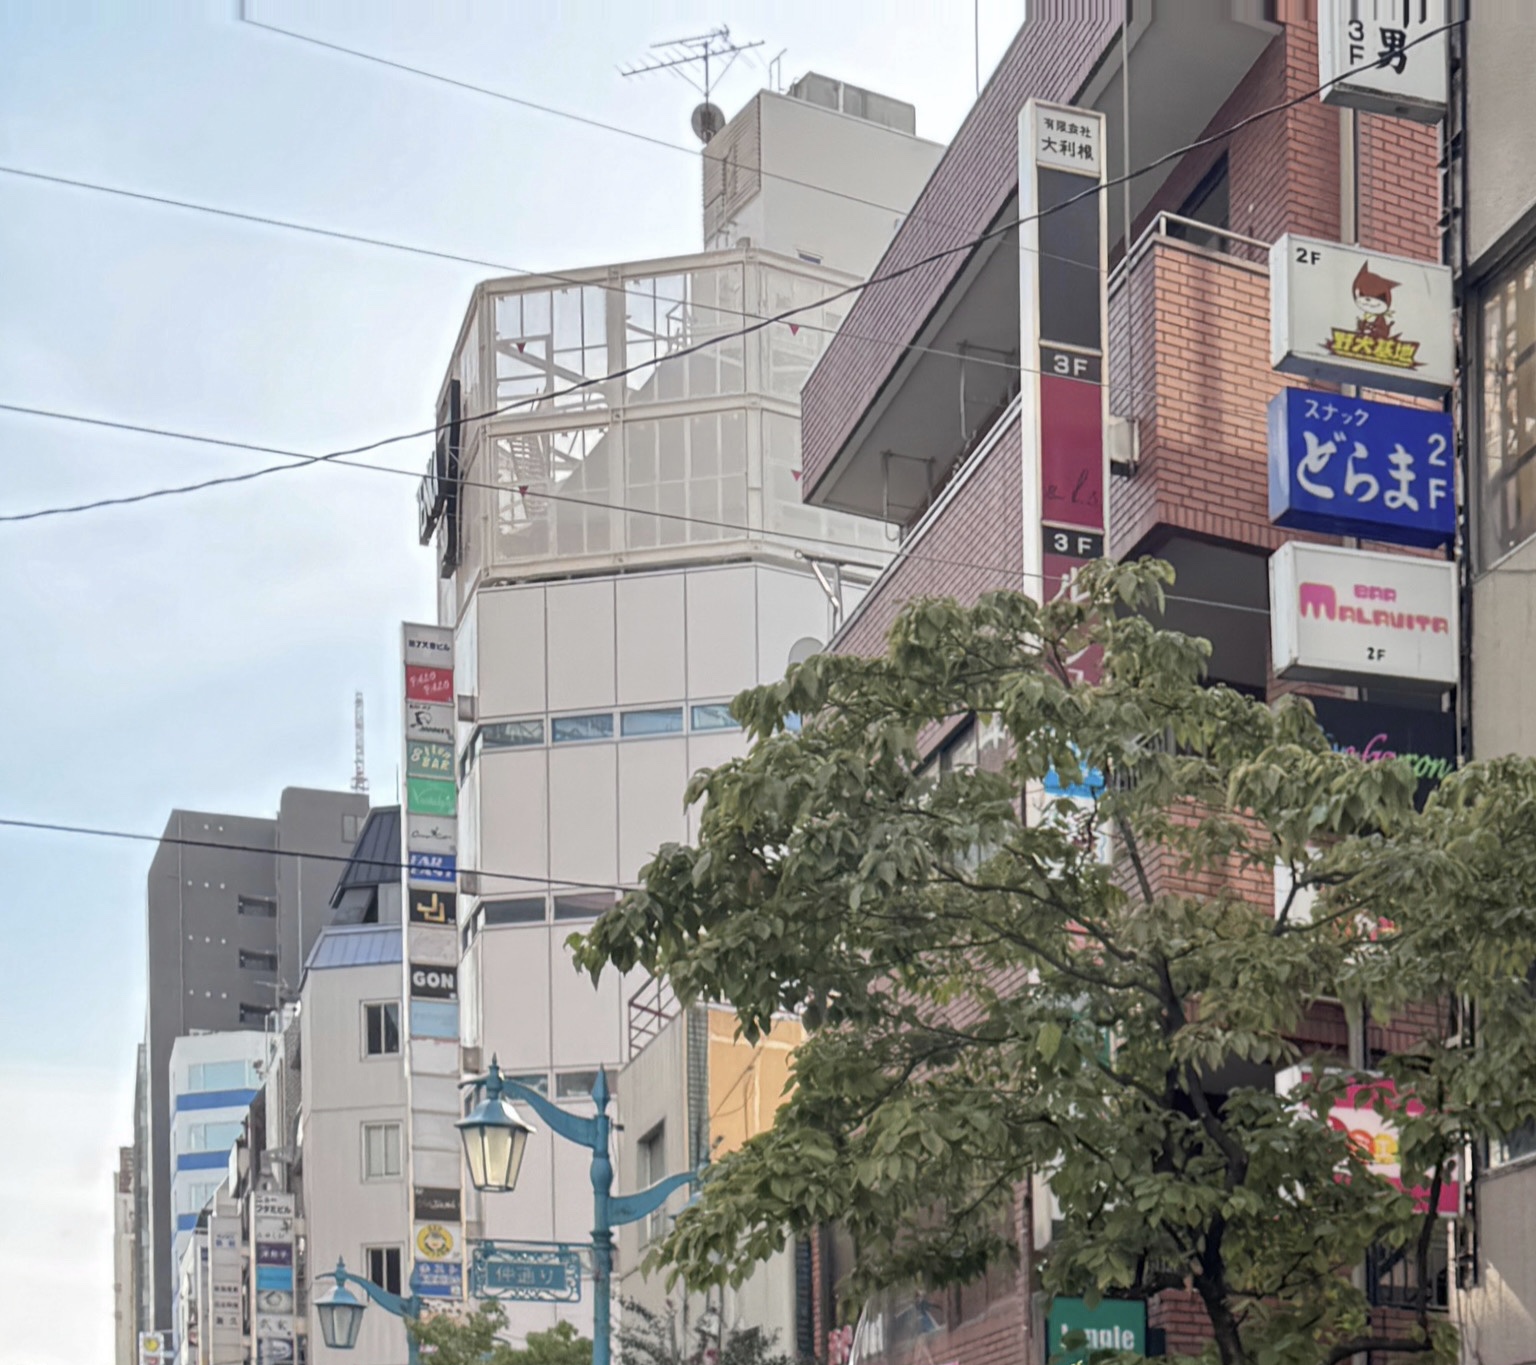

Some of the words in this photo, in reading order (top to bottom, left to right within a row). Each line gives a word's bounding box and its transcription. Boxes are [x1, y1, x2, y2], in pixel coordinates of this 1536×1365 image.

[1348, 20, 1364, 65] 3F
[1044, 118, 1092, 138] 有限会社
[1041, 136, 1094, 161] 大利根
[1296, 247, 1321, 265] 2F
[1053, 354, 1088, 377] 3F
[1304, 399, 1369, 427] スナック
[1296, 430, 1419, 512] どらま
[1427, 433, 1448, 510] 2F
[1053, 533, 1092, 554] 3F
[1354, 584, 1397, 602] BAR
[1367, 647, 1386, 661] 2F
[413, 970, 454, 989] GON
[496, 1265, 553, 1285] 仲通り
